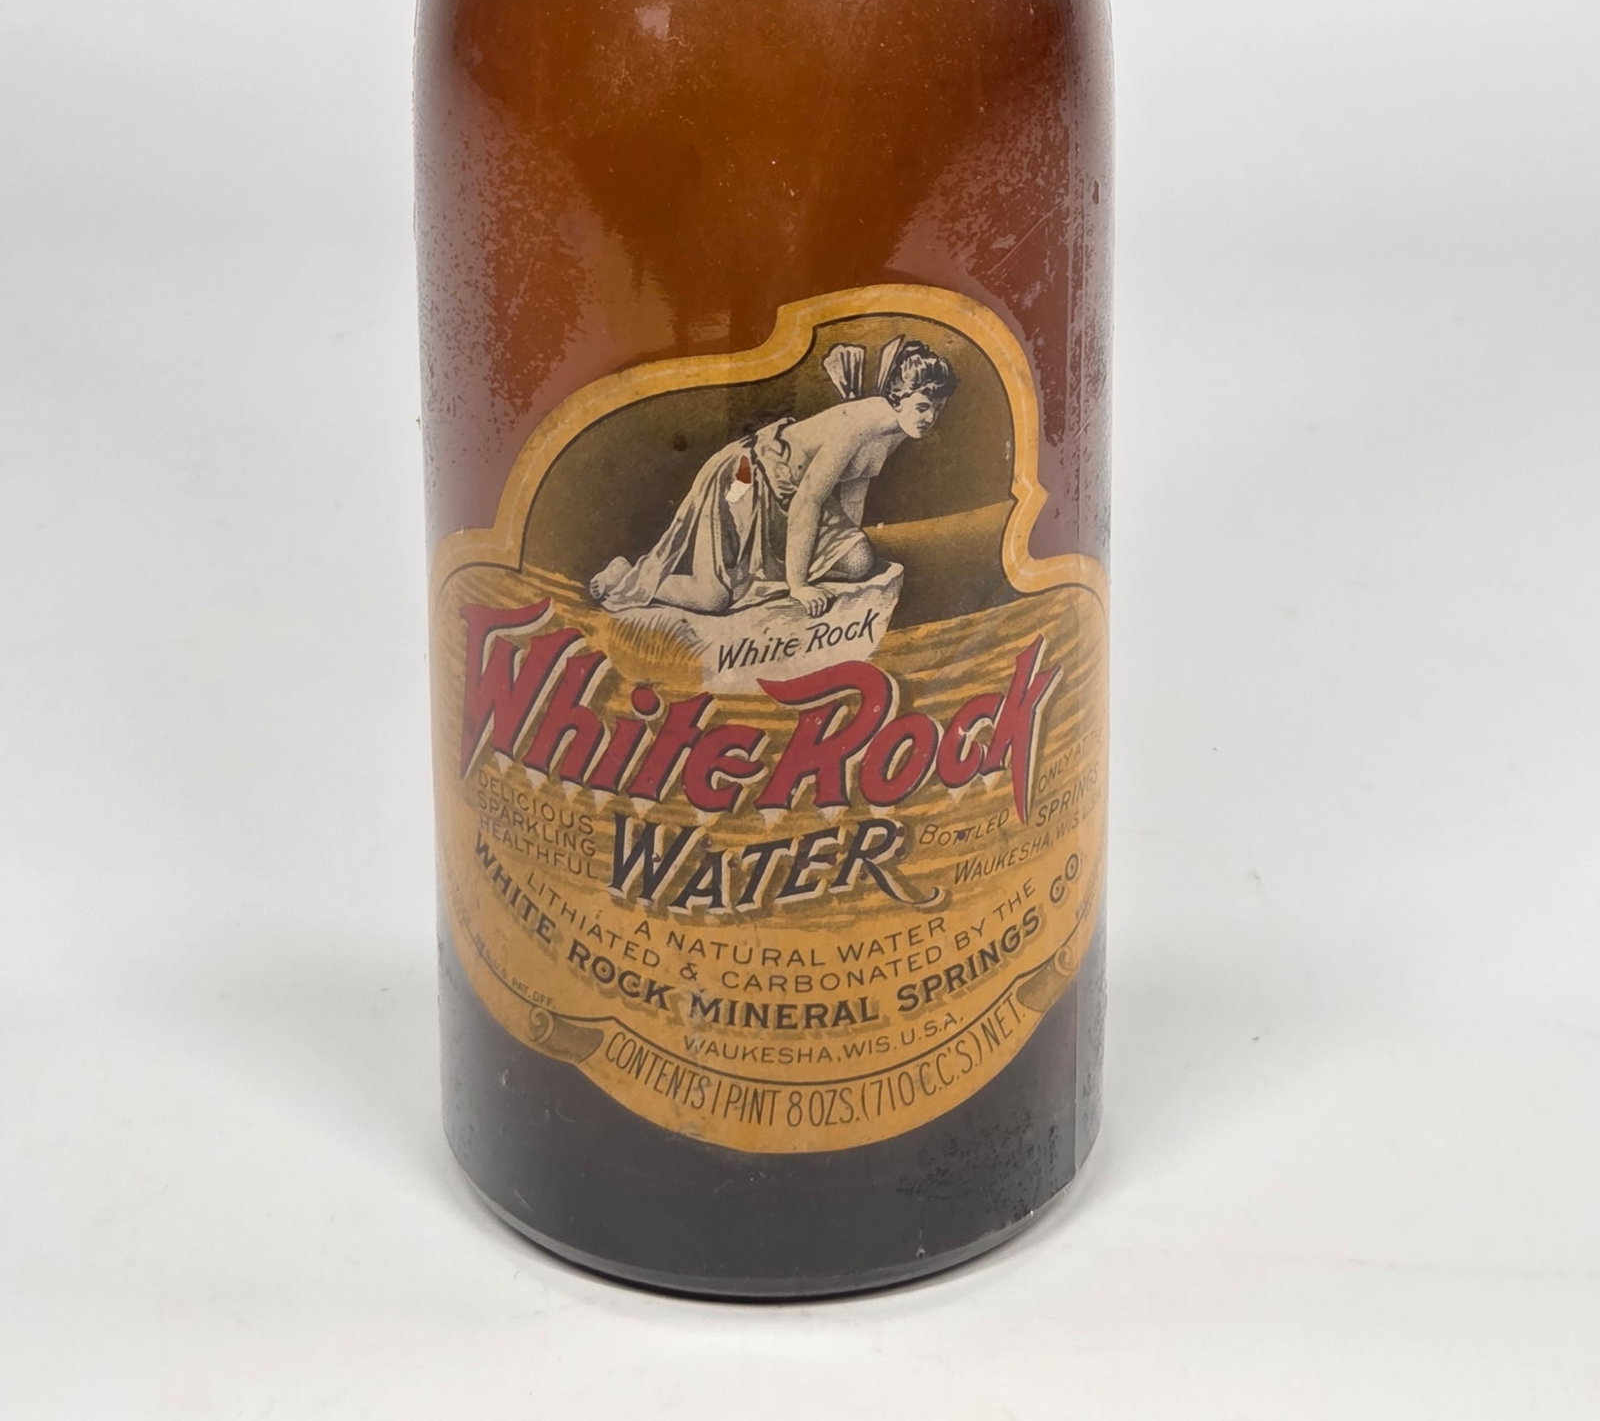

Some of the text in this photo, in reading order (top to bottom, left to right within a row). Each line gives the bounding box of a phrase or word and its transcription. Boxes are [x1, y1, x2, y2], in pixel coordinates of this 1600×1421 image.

[717, 608, 880, 673] White Rock
[459, 595, 1064, 827] White Rock
[479, 768, 594, 836] DELICIOUS
[1038, 747, 1074, 793] ONLY
[477, 789, 597, 858] SPARKLING
[479, 818, 599, 880] HEALTHFUL
[474, 830, 557, 945] WHITE
[566, 938, 675, 1011] ROCK
[689, 994, 880, 1031] MINERAL
[896, 906, 1042, 1013] SPRINGS
[526, 871, 661, 968] LITHIATED
[679, 962, 699, 983] &
[720, 945, 943, 994] CARBONATED
[955, 918, 986, 952] BY
[992, 877, 1036, 922] THE
[634, 916, 947, 969] A NATURAL WATER
[604, 1031, 712, 1111] CONTENTS
[723, 1086, 783, 1127] PINT
[787, 1090, 803, 1127] 8
[809, 1086, 861, 1126] OZS.
